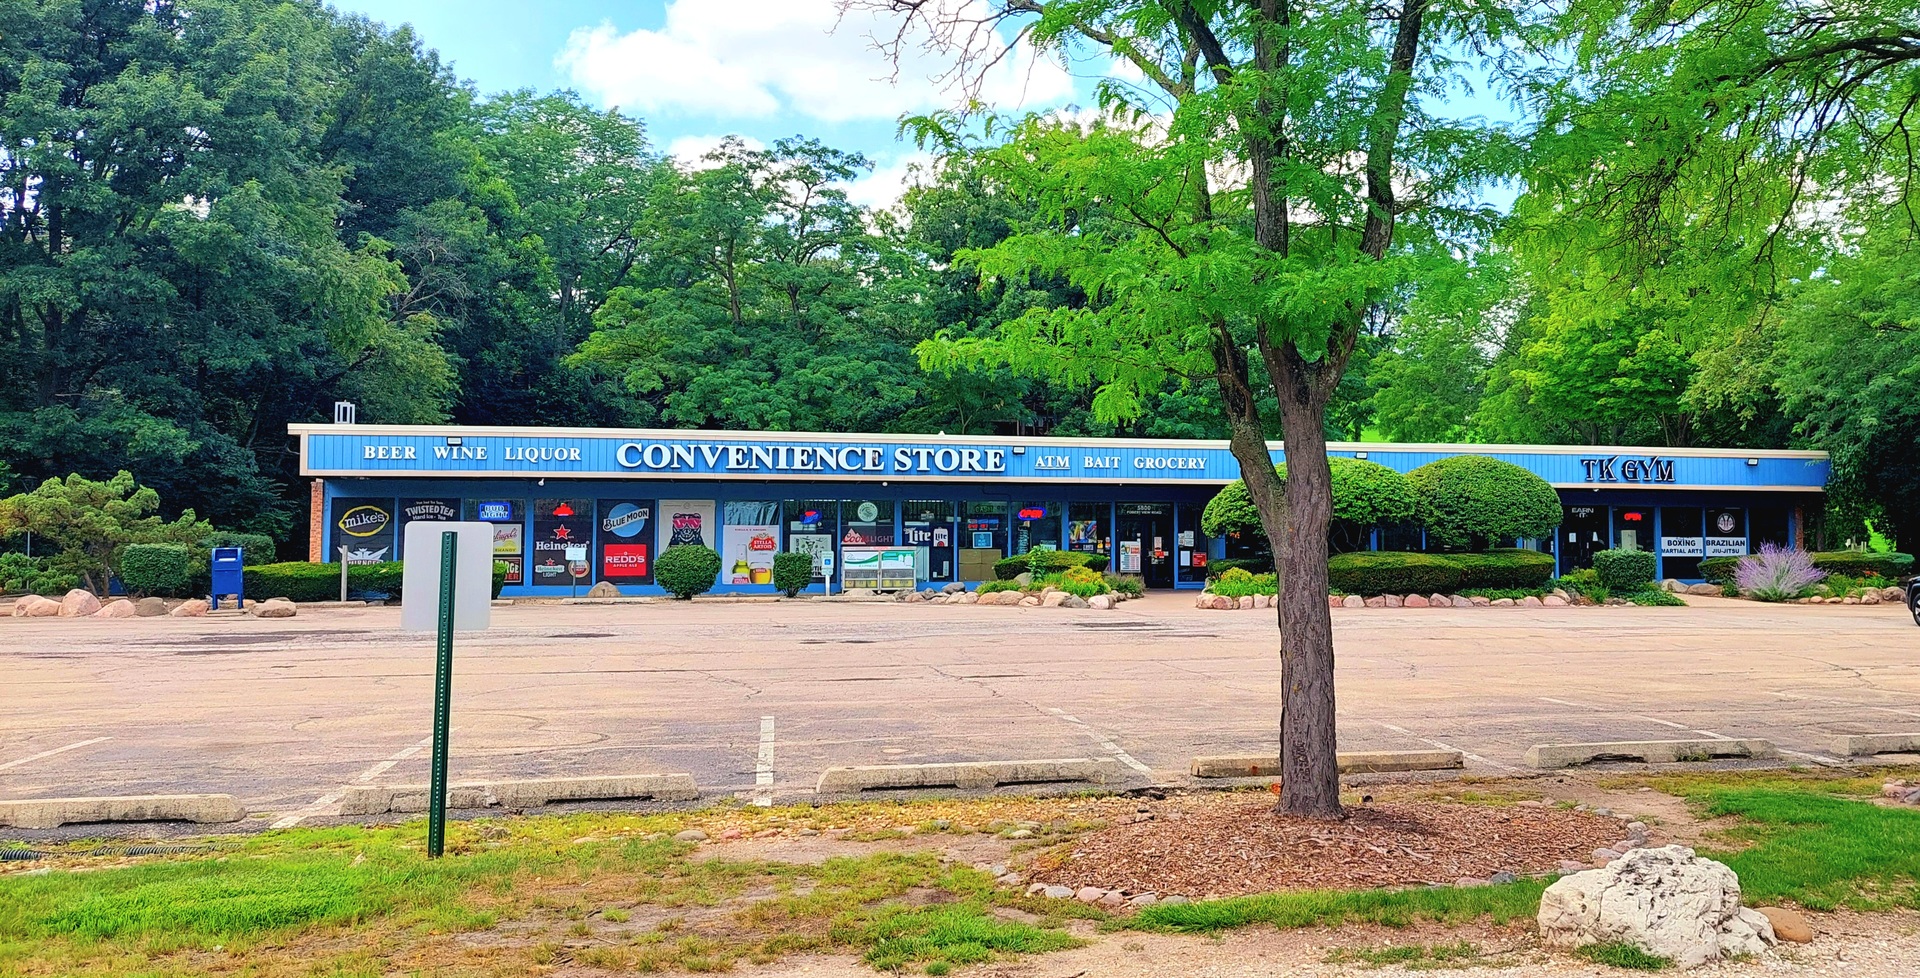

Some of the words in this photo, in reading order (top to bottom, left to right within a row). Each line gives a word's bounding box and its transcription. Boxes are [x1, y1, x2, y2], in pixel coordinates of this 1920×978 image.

[363, 446, 417, 460] BEER
[433, 446, 488, 460] WINE
[504, 447, 582, 463] LIQUOR
[616, 442, 885, 471] CONVENIENCE
[894, 447, 1006, 472] STORE
[1034, 455, 1070, 469] ATM
[1083, 456, 1121, 469] BAIT
[1133, 457, 1207, 470] GROCERY
[1581, 455, 1619, 481] TK
[1621, 456, 1676, 482] GYM
[405, 505, 440, 517] TWISTED
[440, 505, 455, 517] TEA
[481, 511, 508, 519] LIGHT
[1020, 508, 1043, 519] OPEN
[344, 512, 385, 529] mike's
[603, 516, 625, 530] BLUE
[625, 508, 648, 523] MOON
[870, 535, 894, 543] LIGHT
[907, 527, 931, 545] Lite
[935, 533, 947, 541] Lite
[535, 541, 587, 551] Heineken
[1667, 539, 1696, 547] BOXING
[1705, 539, 1745, 547] BRAZILIAN
[605, 553, 645, 563] REDD'S
